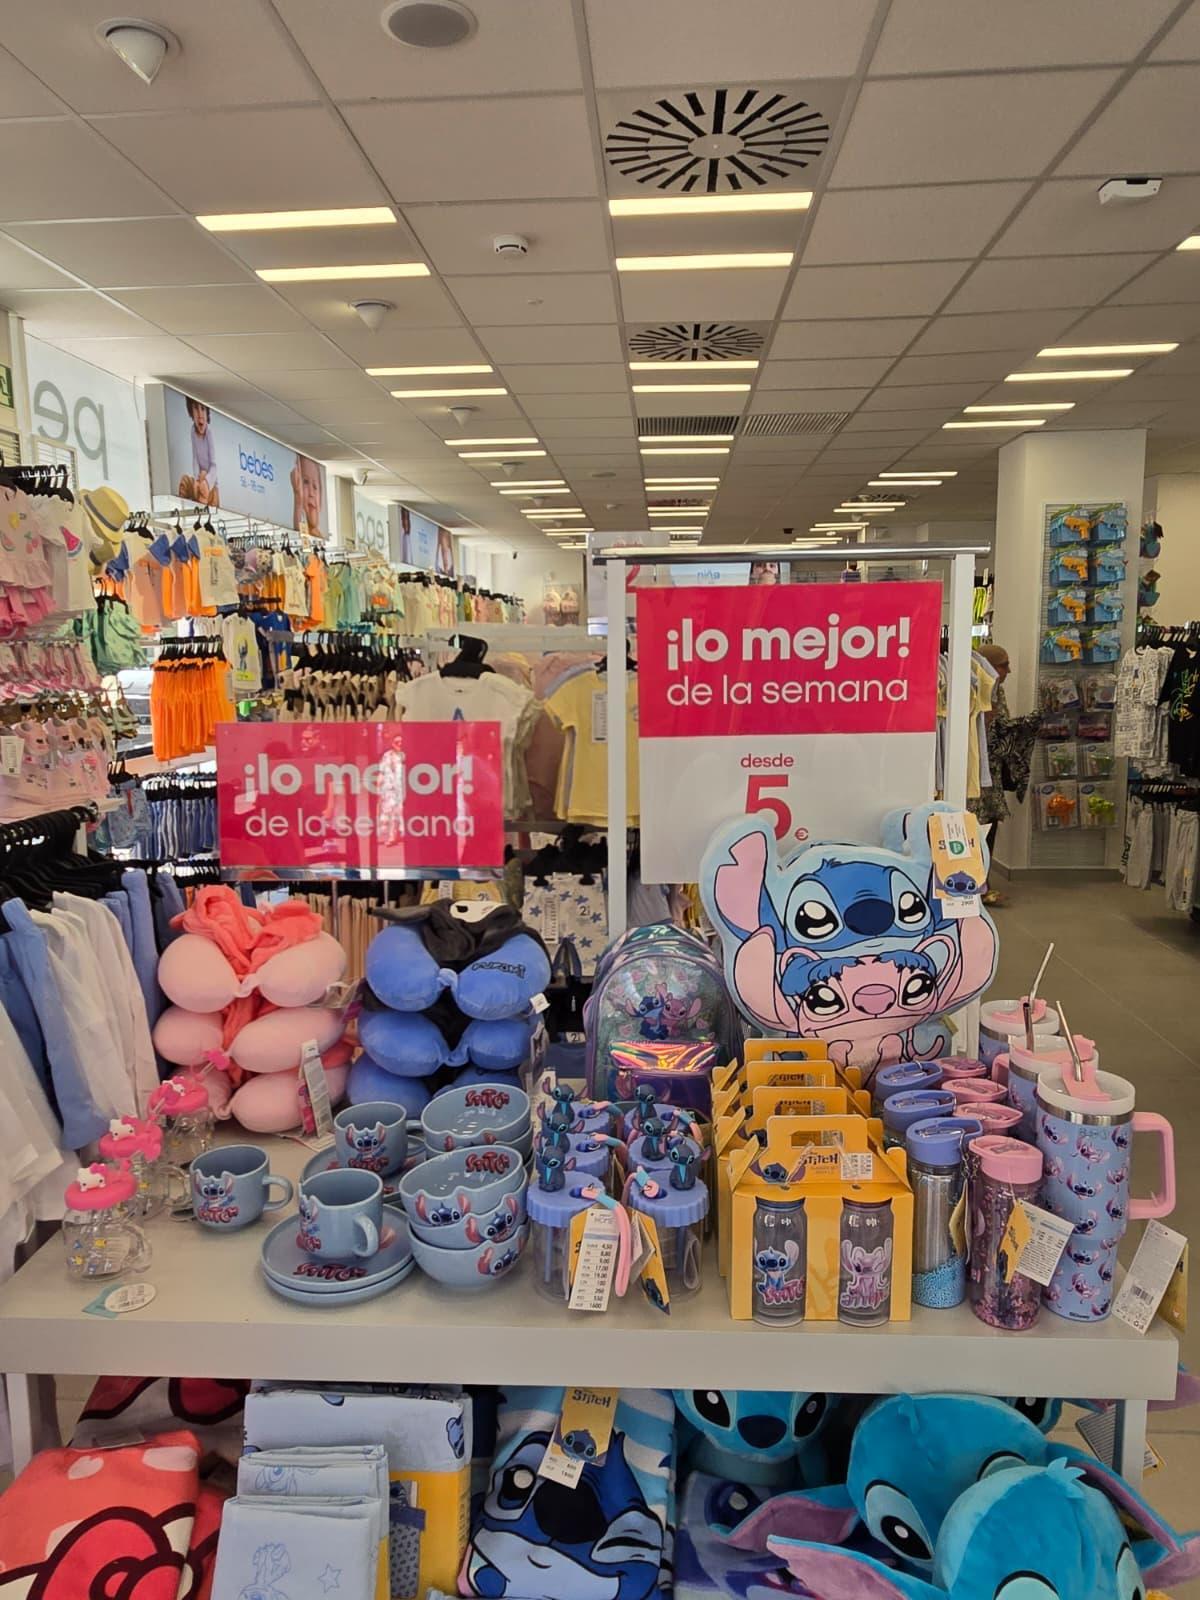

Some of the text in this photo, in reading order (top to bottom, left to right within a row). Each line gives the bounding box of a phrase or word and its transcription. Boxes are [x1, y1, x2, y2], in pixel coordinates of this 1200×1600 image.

[239, 442, 274, 481] bebés
[741, 612, 911, 671] mejor!
[667, 674, 909, 706] de la semana
[740, 753, 794, 769] desde
[245, 808, 289, 837] de
[298, 807, 326, 837] la
[745, 774, 792, 841] 5
